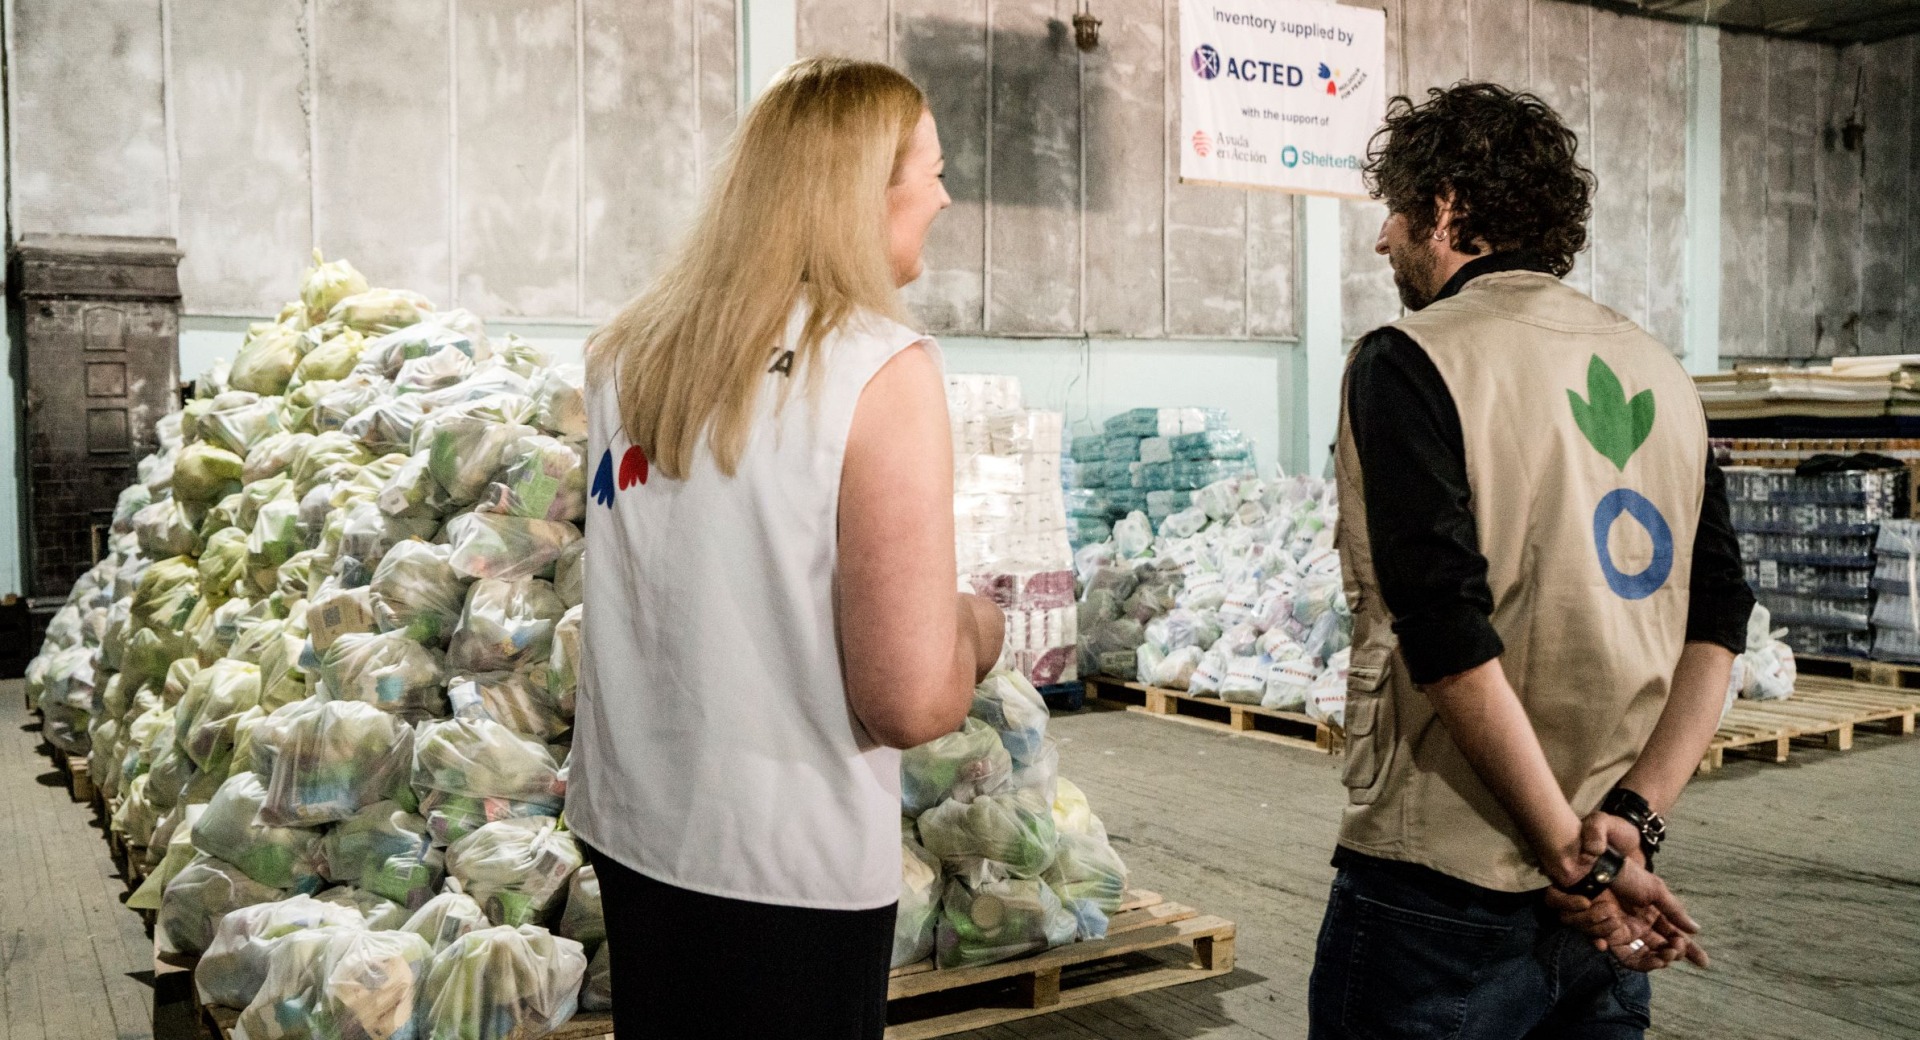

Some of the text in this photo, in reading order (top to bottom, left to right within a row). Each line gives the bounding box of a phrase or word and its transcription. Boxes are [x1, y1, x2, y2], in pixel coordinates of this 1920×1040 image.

[1212, 6, 1354, 46] Inventory supplied by
[1226, 57, 1304, 87] ACTED
[1241, 108, 1329, 127] with the support of
[1231, 149, 1268, 165] Acción
